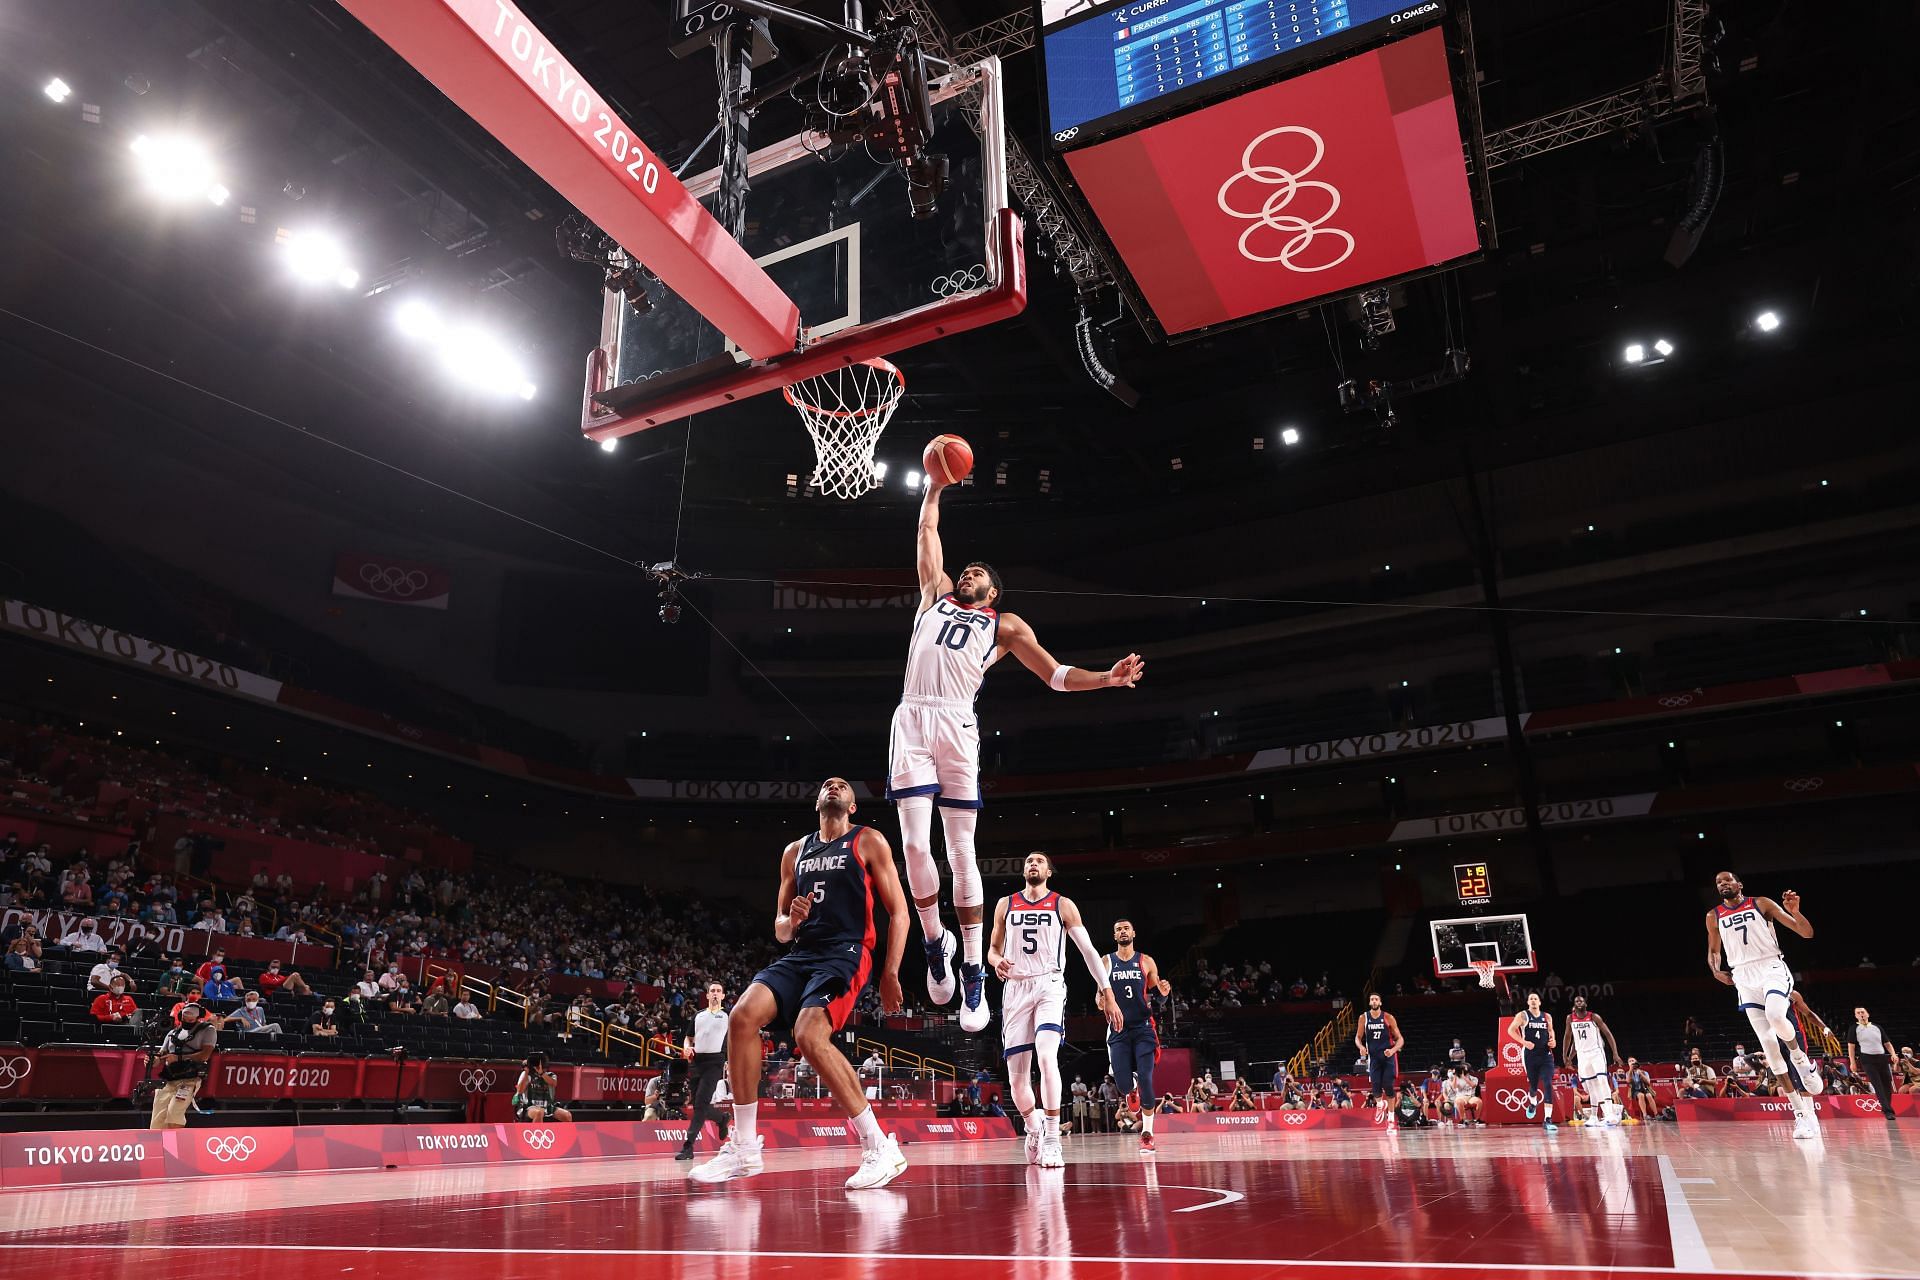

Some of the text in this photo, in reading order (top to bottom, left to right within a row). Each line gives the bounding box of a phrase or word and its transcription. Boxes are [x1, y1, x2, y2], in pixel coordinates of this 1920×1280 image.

[1130, 0, 1169, 16] CURRE
[1267, 1, 1274, 9] 2
[1402, 2, 1438, 20] OMEGA
[1133, 15, 1169, 32] FRANCE
[1205, 12, 1219, 21] PTS
[1238, 3, 1296, 30] 7 2 2
[1235, 33, 1247, 42] 10
[1271, 22, 1277, 30] 1
[1291, 14, 1298, 22] 0
[1237, 43, 1248, 53] 12
[1272, 32, 1279, 40] 2
[1292, 25, 1300, 33] 0
[1313, 17, 1320, 25] 3
[1153, 43, 1160, 51] 0
[1191, 29, 1198, 37] 2
[1238, 54, 1250, 63] 14
[1274, 43, 1281, 51] 1
[1315, 28, 1322, 36] 1
[1336, 21, 1343, 29] 0
[1175, 57, 1181, 65] 2
[1194, 50, 1200, 58] 1
[1157, 74, 1163, 82] 1
[1176, 67, 1183, 75] 2
[1195, 60, 1202, 68] 4
[1124, 94, 1135, 104] 27
[1158, 84, 1165, 92] 2
[1177, 77, 1184, 85] 0
[1214, 64, 1225, 72] 16
[494, 0, 659, 194] TOKYO 2020
[937, 602, 990, 631] USA
[0, 598, 239, 689] TOKYO 2020
[935, 620, 971, 650] 10
[1285, 722, 1475, 766] TOKYO 2020
[668, 780, 817, 800] TOKYO 202
[1431, 799, 1614, 835] TOKYO 2020
[799, 855, 847, 875] FRANCE
[813, 881, 826, 904] 5
[1461, 879, 1486, 896] 22
[1011, 914, 1051, 926] USA
[1722, 912, 1755, 928] USA
[1023, 929, 1037, 954] 5
[1735, 925, 1748, 945] 7
[1113, 970, 1141, 981] FRANCE
[1125, 986, 1133, 998] 3
[1373, 1031, 1381, 1039] 27
[1535, 1030, 1540, 1039] 4
[1577, 1029, 1587, 1040] 14
[225, 1066, 330, 1087] TOKYO 2020
[596, 1077, 648, 1092] TOKYO 202
[1761, 1103, 1794, 1111] TOKYO
[1216, 1116, 1259, 1125] TOKYO 2020
[655, 1130, 682, 1141] TOKYO
[812, 1126, 847, 1137] TOKYO 2020
[417, 1134, 489, 1150] TOKYO 2020
[24, 1144, 145, 1165] TOKYO 2020
